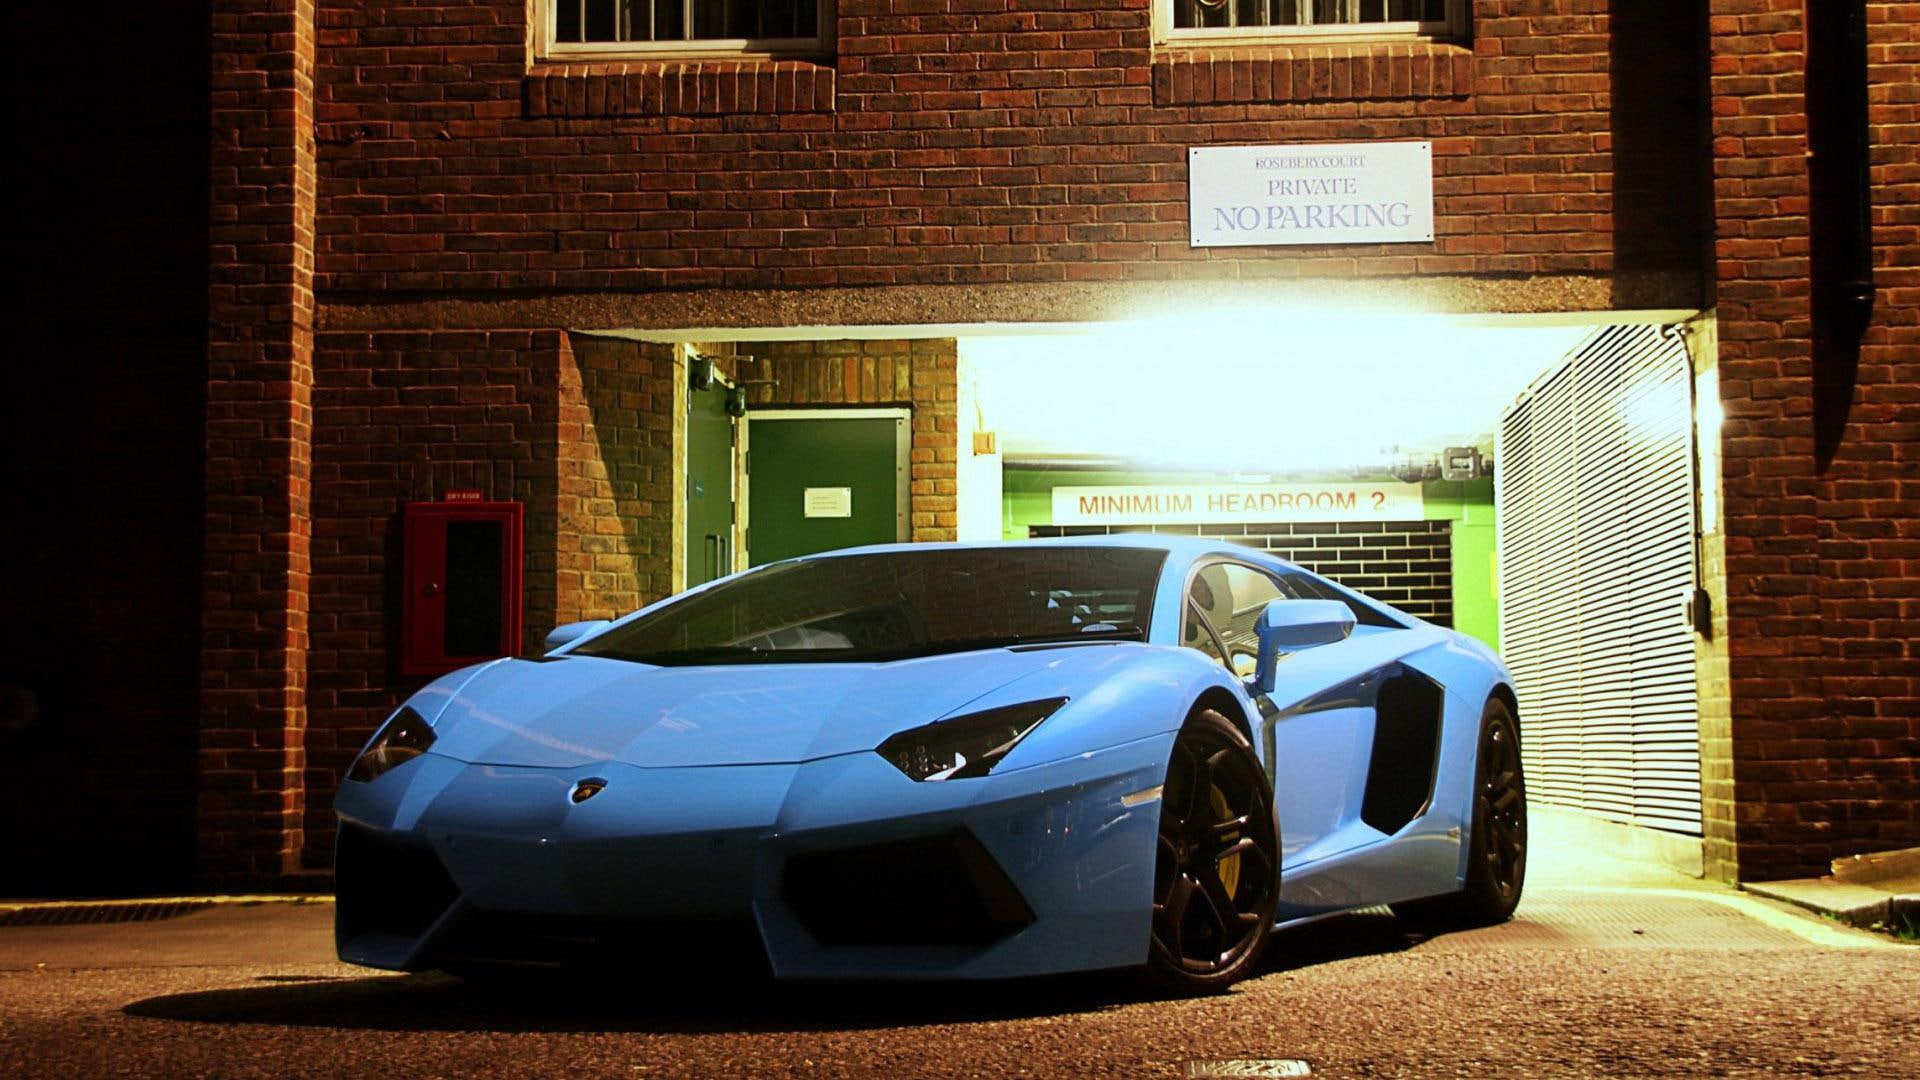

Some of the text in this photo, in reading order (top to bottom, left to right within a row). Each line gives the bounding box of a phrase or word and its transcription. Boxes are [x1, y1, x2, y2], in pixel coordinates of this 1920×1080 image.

[1256, 155, 1366, 170] ROSEBERY COURT
[1268, 177, 1357, 196] PRIVATE
[1213, 202, 1412, 231] NO PARKING
[1079, 494, 1192, 514] MINIMUM
[1207, 491, 1357, 513] HEADROOM
